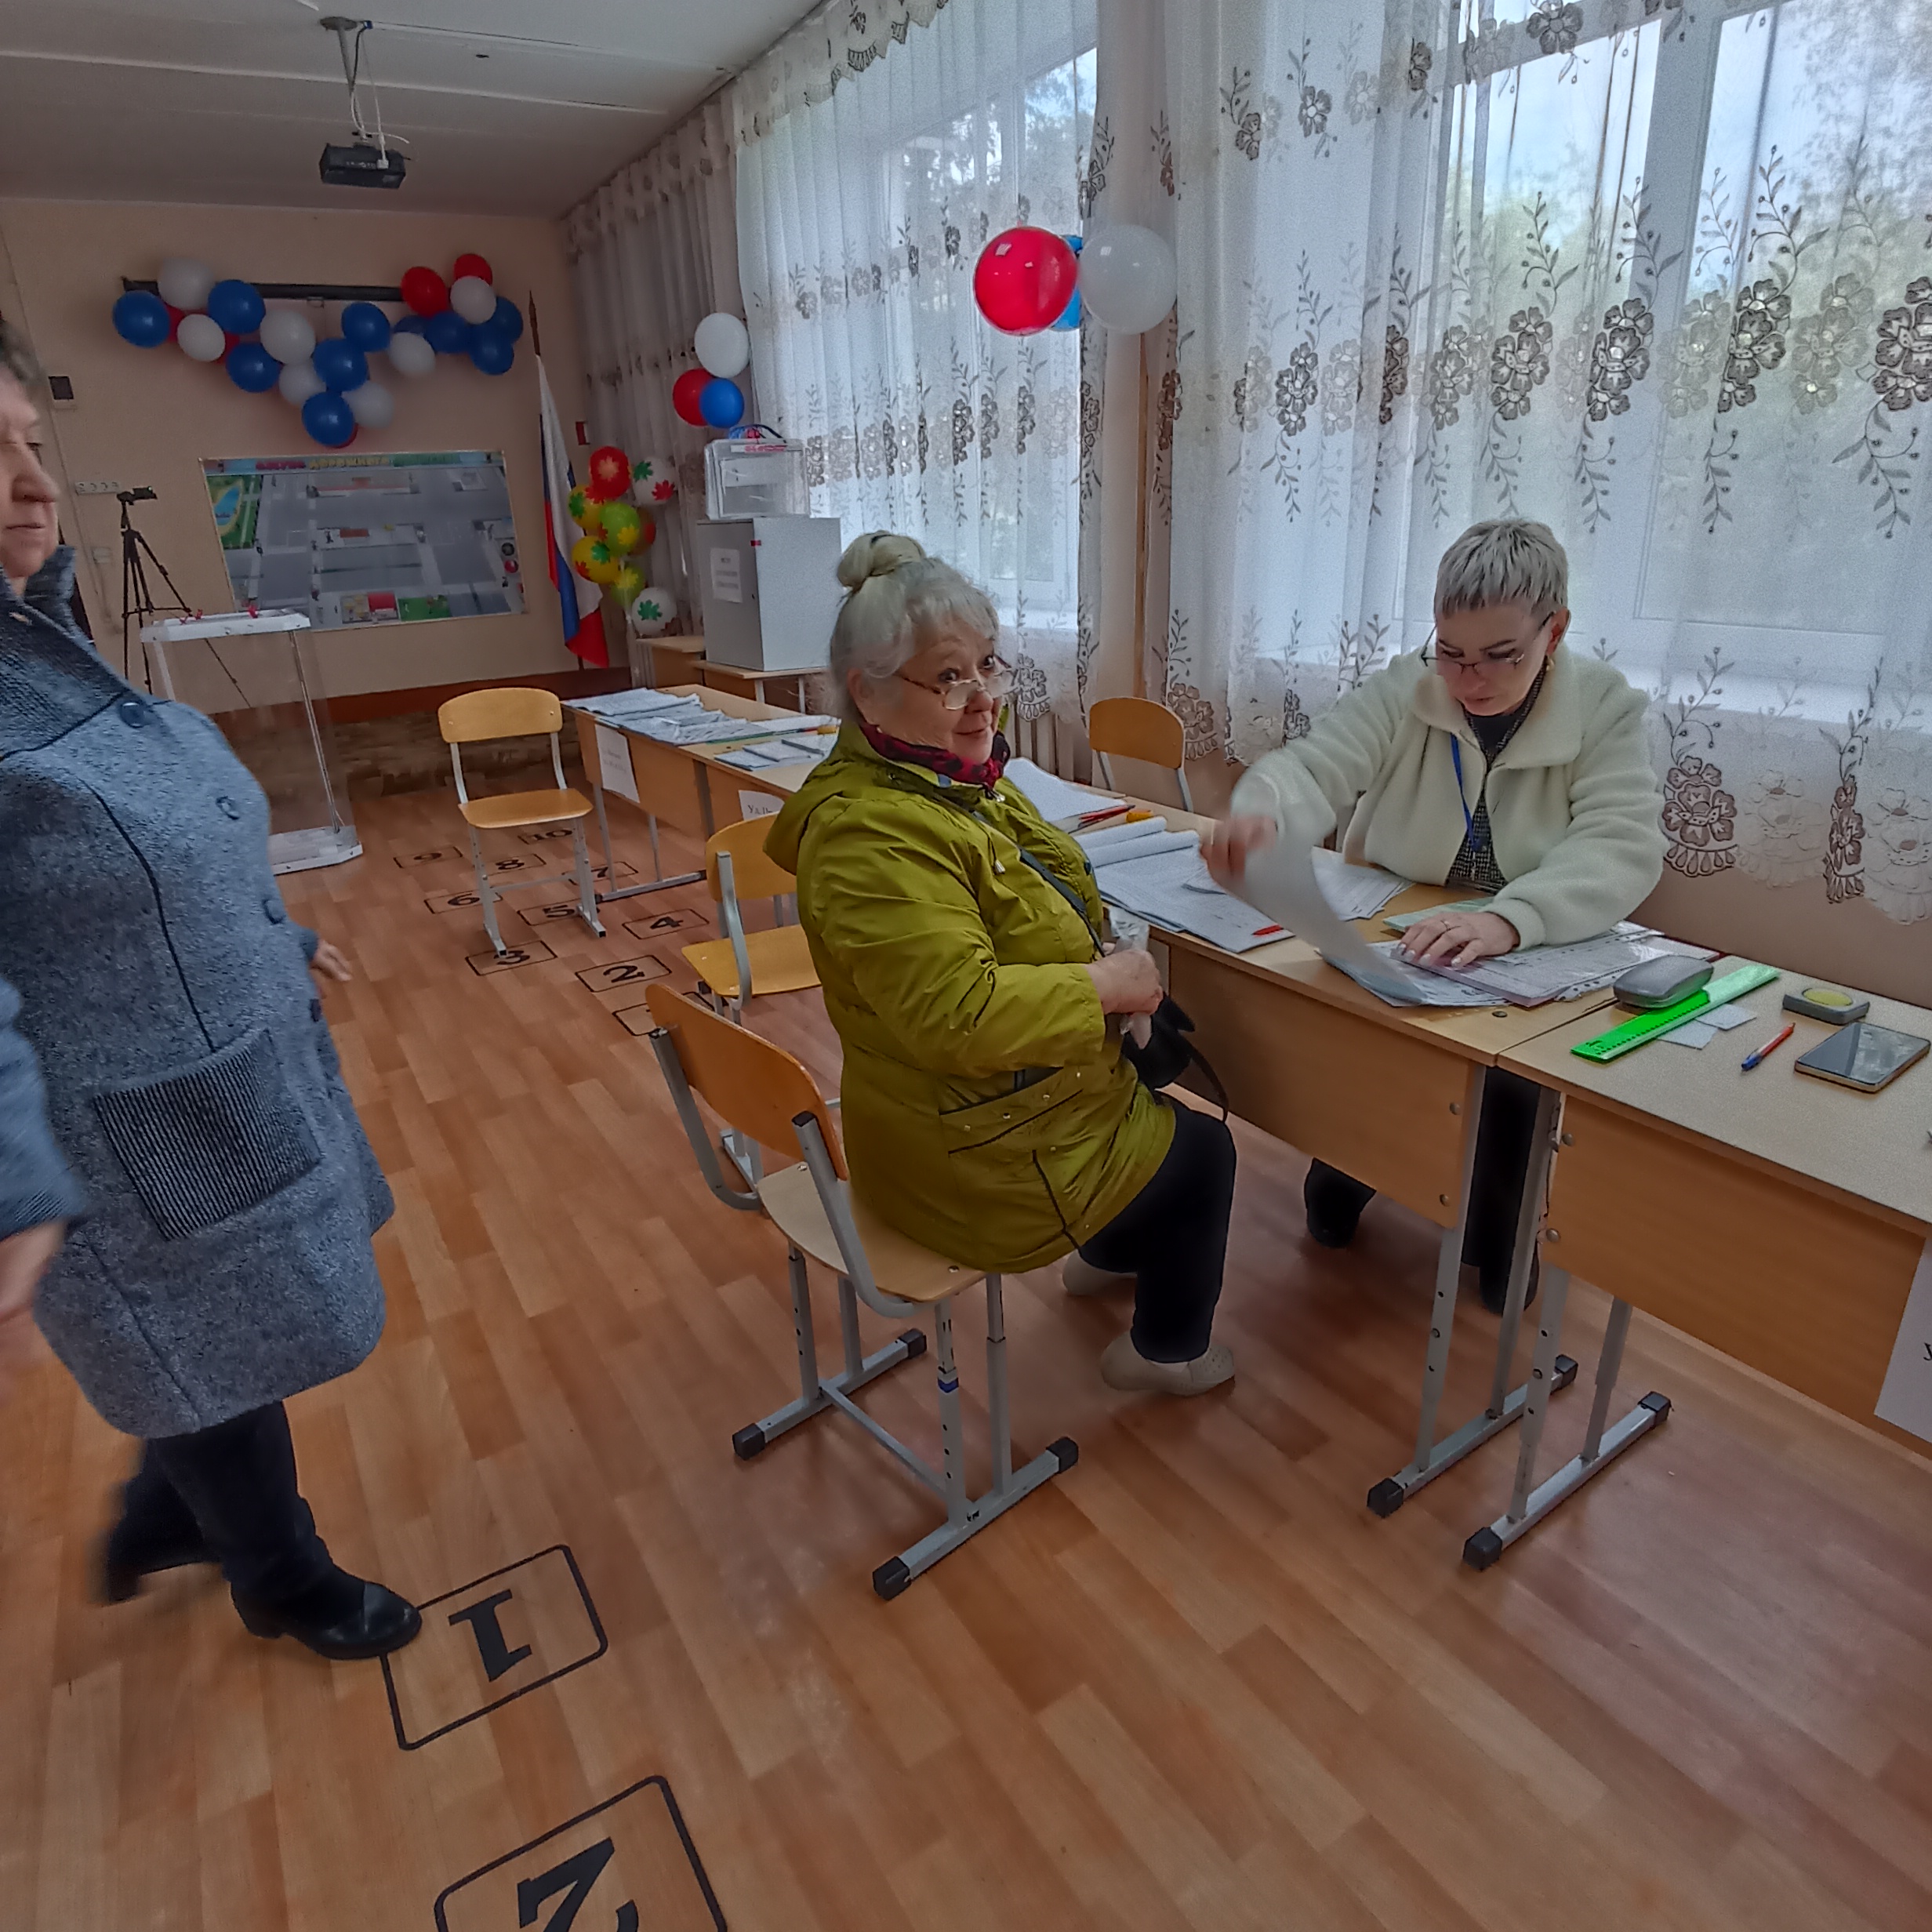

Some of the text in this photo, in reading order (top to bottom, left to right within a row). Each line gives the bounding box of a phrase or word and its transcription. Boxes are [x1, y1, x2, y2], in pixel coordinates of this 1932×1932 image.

[533, 829, 573, 841] 10
[495, 859, 525, 871] 8
[447, 893, 481, 906] 6
[543, 904, 576, 918] 5
[649, 916, 685, 930] 4
[493, 950, 531, 966] 3
[602, 965, 645, 983] 2
[448, 1589, 532, 1683] 1
[517, 1836, 640, 1932] 2
